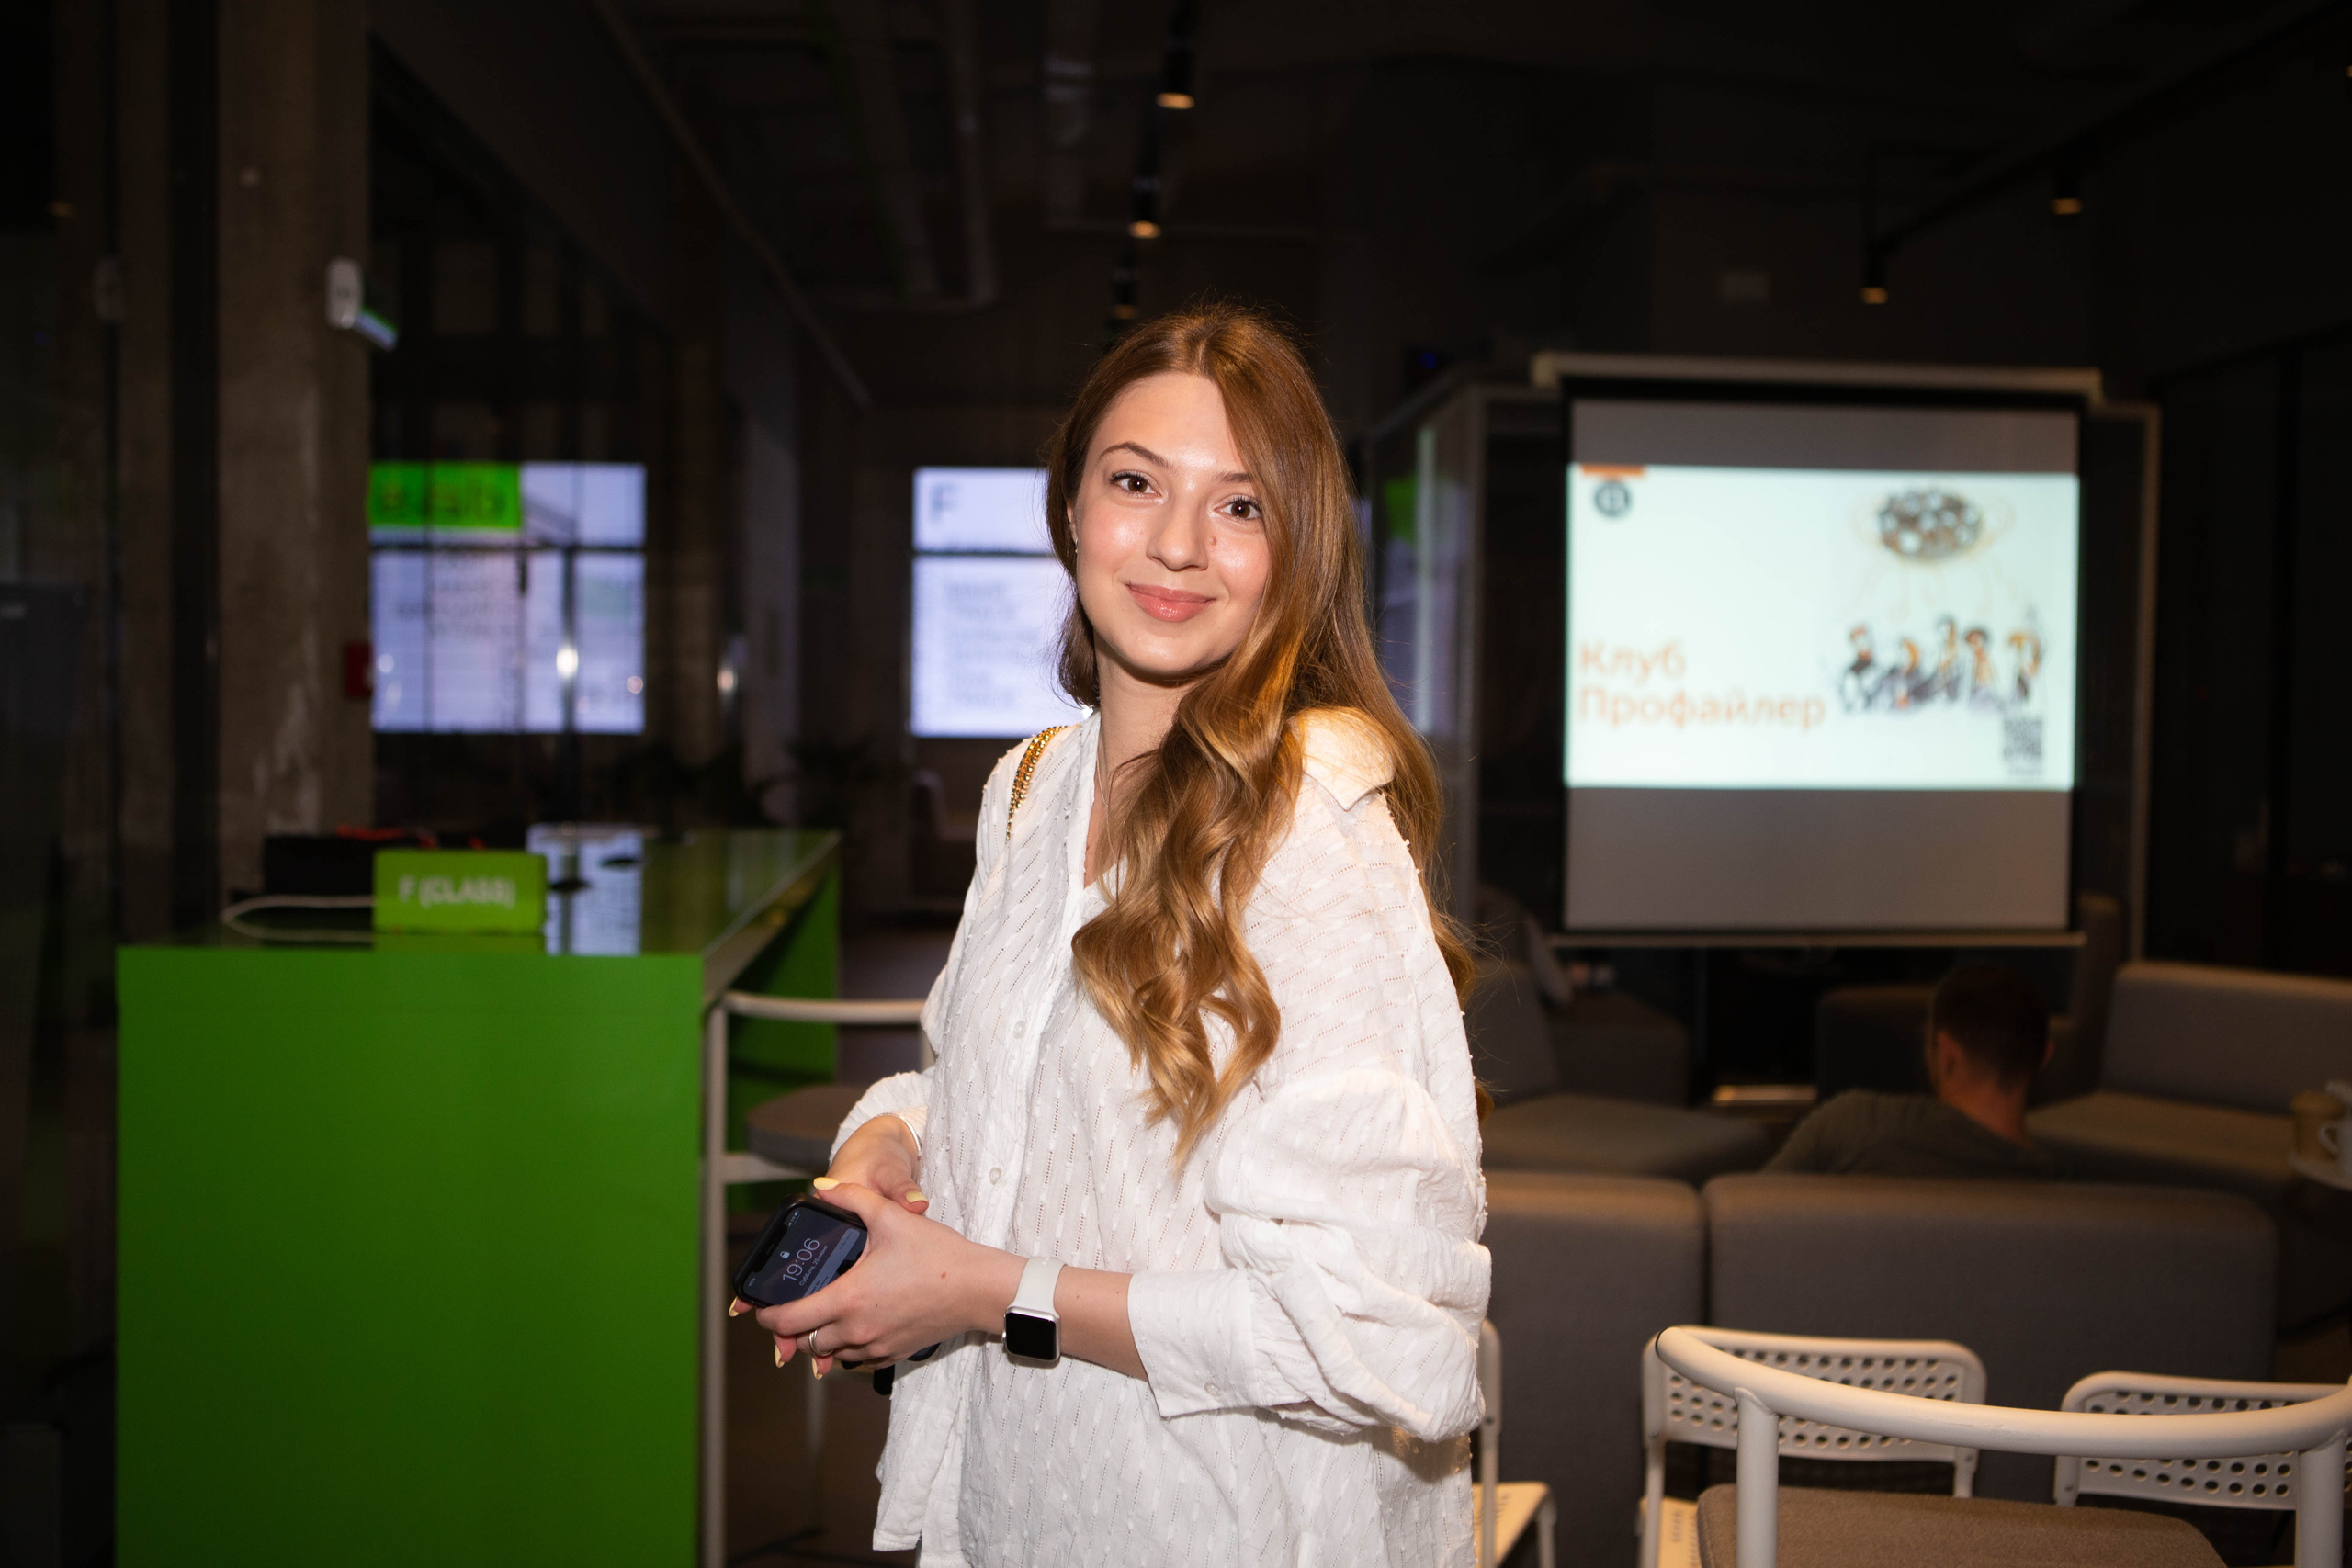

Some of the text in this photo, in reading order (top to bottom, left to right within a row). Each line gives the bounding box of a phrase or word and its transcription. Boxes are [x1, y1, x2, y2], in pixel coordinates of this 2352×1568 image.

[1579, 640, 1687, 685] Клуб
[1578, 687, 1826, 732] Профайлер
[398, 876, 416, 902] F
[783, 1238, 820, 1281] 19:06
